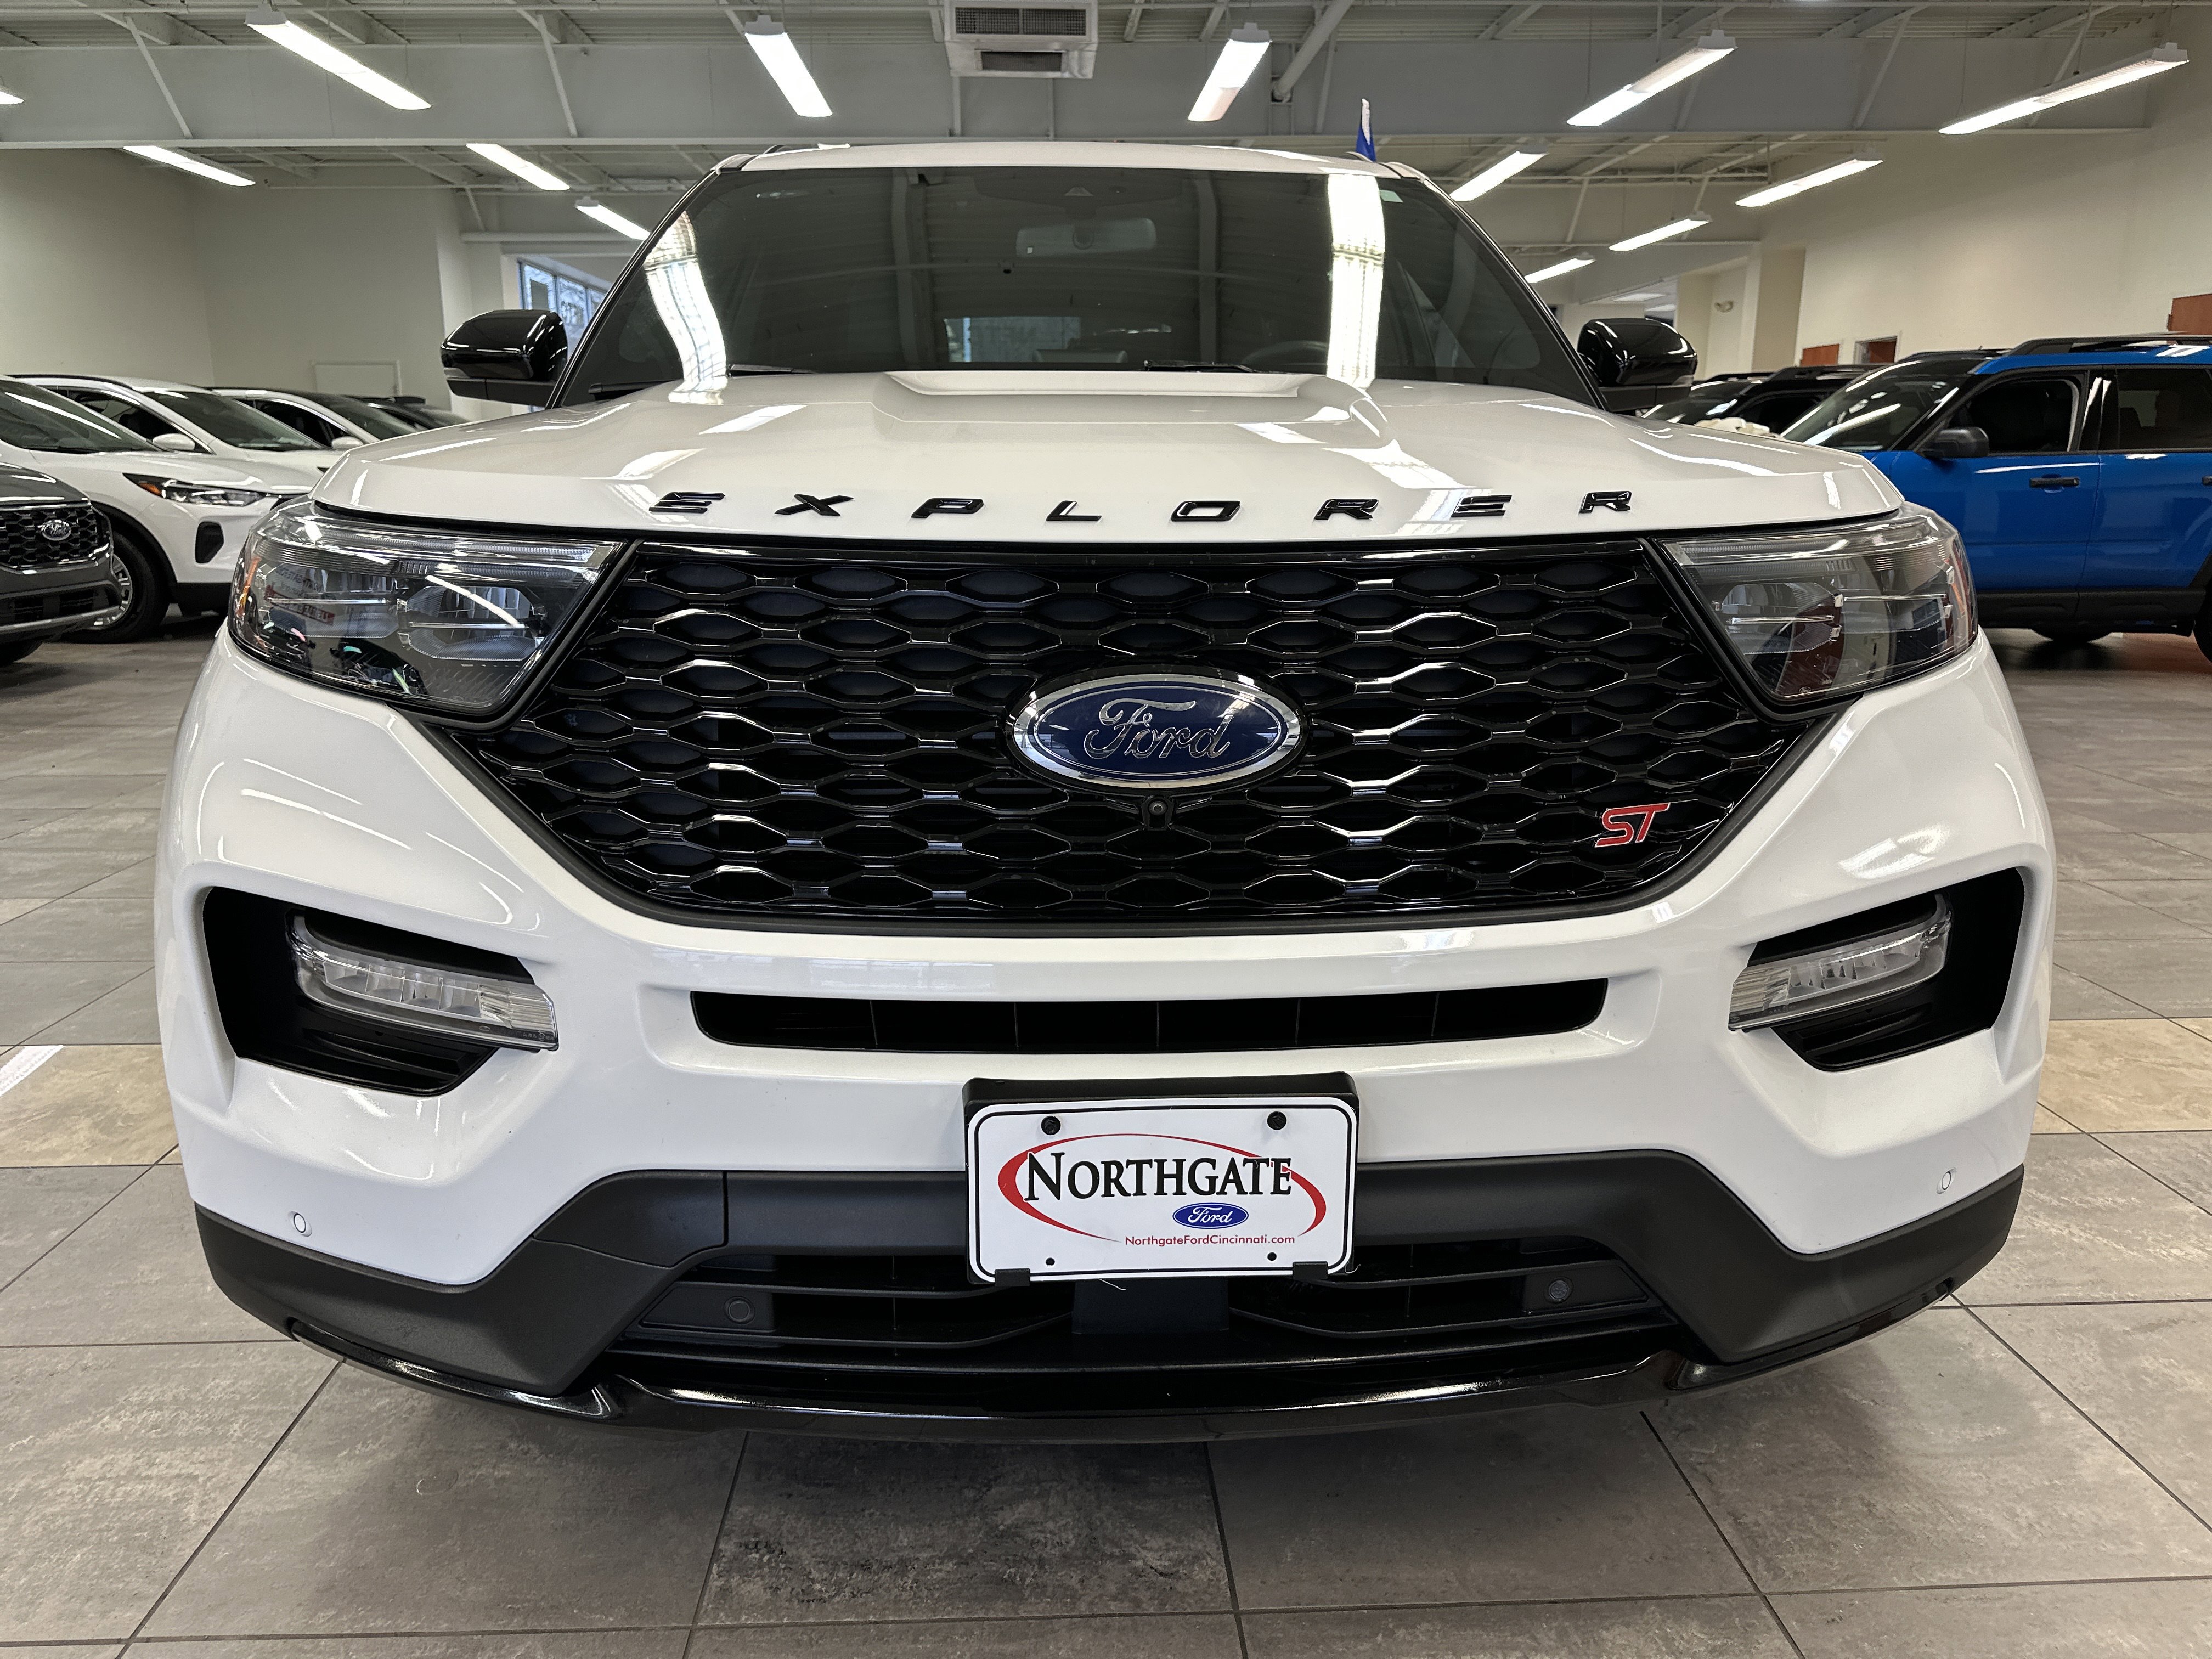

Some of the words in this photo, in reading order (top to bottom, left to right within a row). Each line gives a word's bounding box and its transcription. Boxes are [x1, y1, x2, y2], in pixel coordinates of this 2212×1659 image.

[648, 490, 1633, 522] EXPLORER
[1084, 698, 1235, 759] Ford
[1594, 802, 1671, 848] ST
[1024, 1152, 1291, 1201] NORTHGATE
[1188, 1206, 1233, 1224] Ford
[1125, 1234, 1295, 1248] NorthgateFordCincinnati.com
